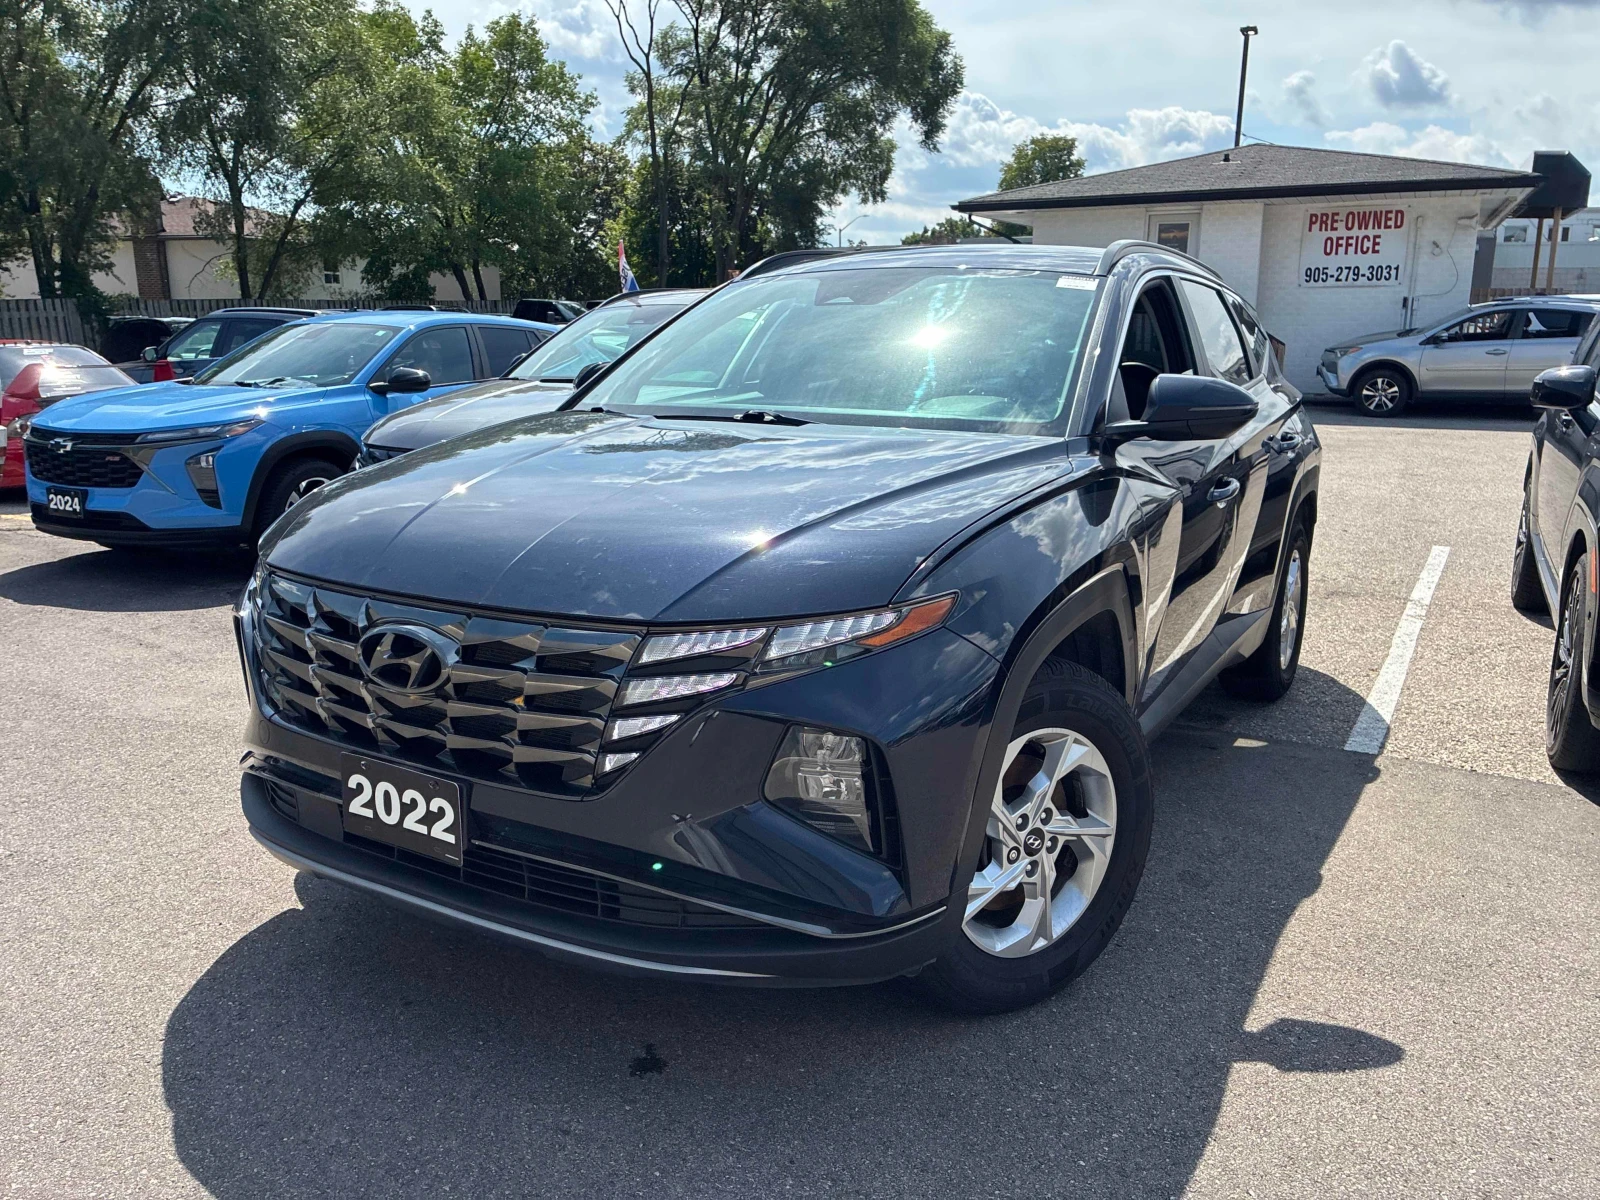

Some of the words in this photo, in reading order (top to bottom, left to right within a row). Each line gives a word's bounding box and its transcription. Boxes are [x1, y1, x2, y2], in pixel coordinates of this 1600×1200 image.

[1308, 209, 1405, 232] PRE-OWNED
[1323, 234, 1382, 256] OFFICE
[1304, 264, 1400, 283] 905-279-3031
[48, 493, 81, 512] 2024
[347, 773, 456, 845] 2022
